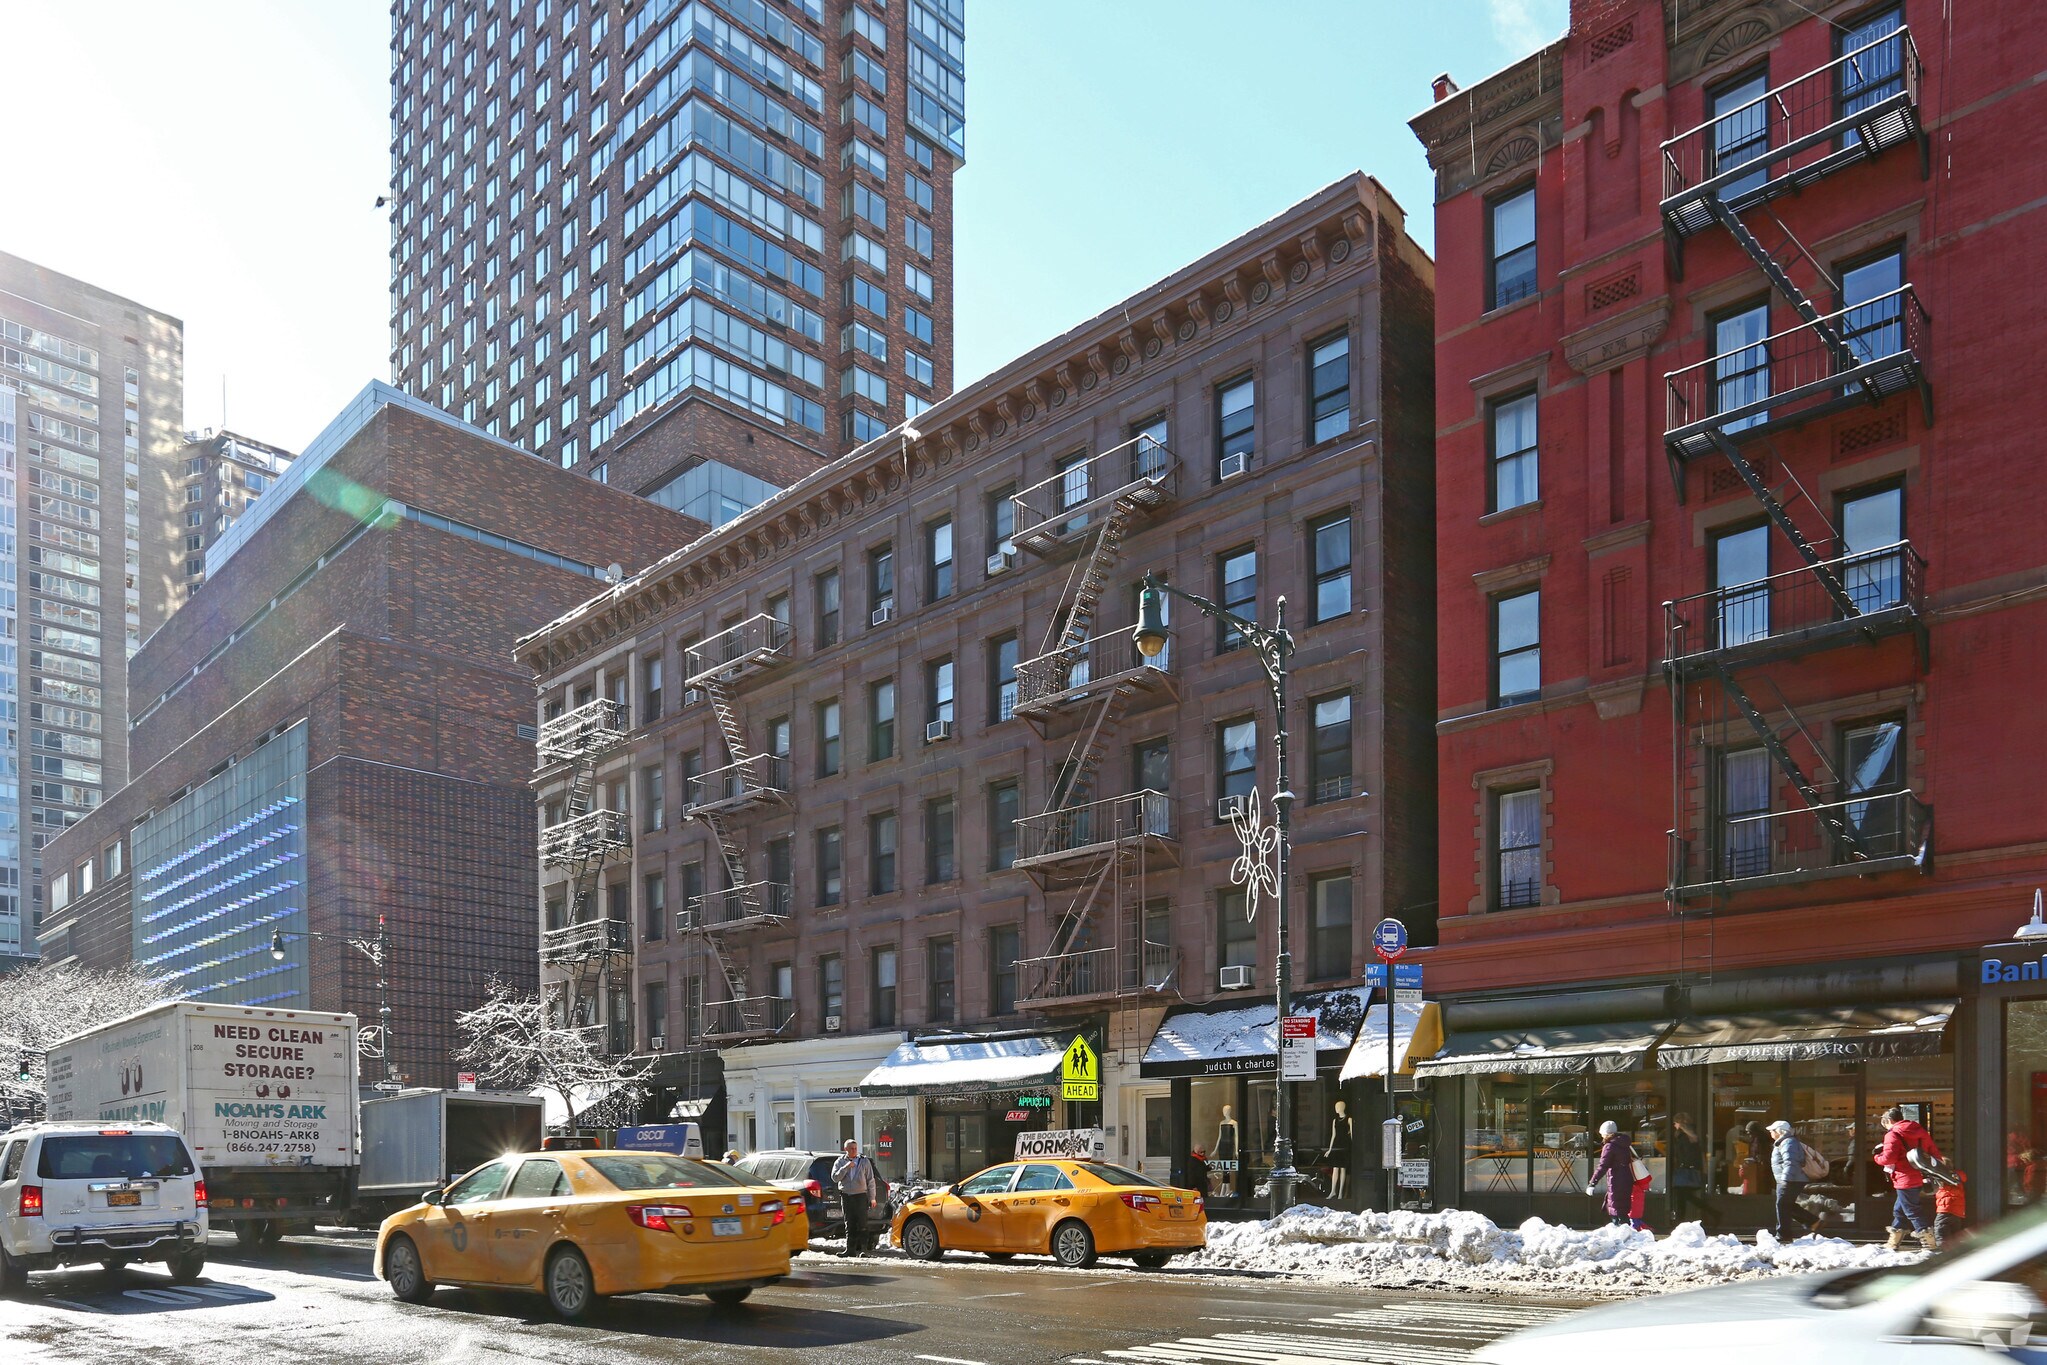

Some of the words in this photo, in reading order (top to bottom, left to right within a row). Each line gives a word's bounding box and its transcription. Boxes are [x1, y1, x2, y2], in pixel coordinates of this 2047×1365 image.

[1368, 966, 1378, 974] M7
[1368, 978, 1380, 986] M11
[214, 1025, 260, 1039] NEED
[268, 1028, 323, 1044] CLEAN
[236, 1044, 304, 1061] SECURE
[1726, 1044, 1798, 1057] ROBERT
[1801, 1043, 1858, 1054] MARC
[224, 1063, 315, 1079] STORAGE?
[1204, 1061, 1232, 1074] judith
[1237, 1061, 1241, 1069] &
[1245, 1059, 1275, 1069] charles
[1472, 1061, 1528, 1071] ROBERT
[1532, 1060, 1575, 1070] MARC
[1066, 1086, 1094, 1096] AHEAD
[215, 1103, 285, 1118] NOAH'S
[287, 1105, 327, 1119] ARK
[225, 1119, 259, 1128] Moving
[284, 1120, 318, 1128] Storage
[1408, 1120, 1423, 1131] OPEN
[222, 1130, 320, 1140] 1-8NOAHS-ARK8
[637, 1130, 666, 1140] oscar
[226, 1142, 316, 1153] (866.247.2758)
[1561, 1150, 1586, 1158] BEACH
[1210, 1161, 1237, 1170] SALE
